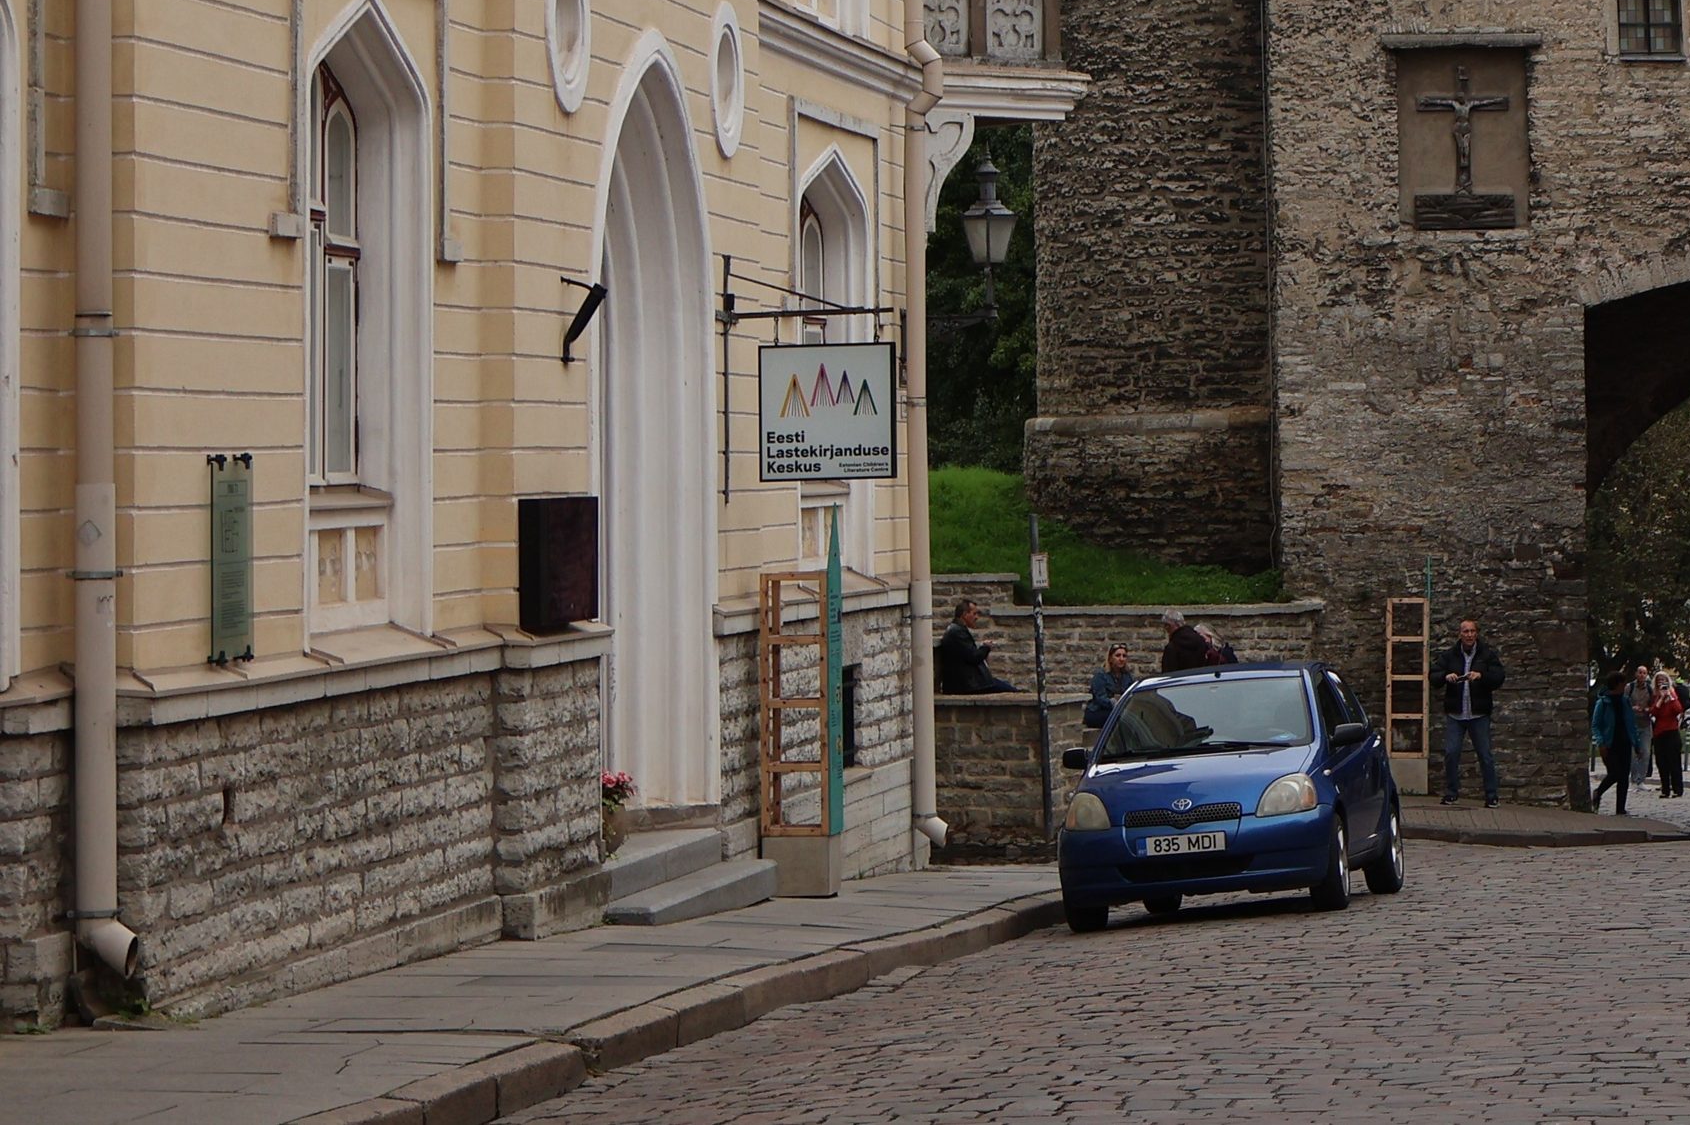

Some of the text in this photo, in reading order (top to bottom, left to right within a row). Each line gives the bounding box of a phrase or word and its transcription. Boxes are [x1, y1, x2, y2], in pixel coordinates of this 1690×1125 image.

[766, 430, 805, 444] Eesti
[766, 444, 890, 460] Lastekirjanduse
[767, 460, 822, 474] Keskus
[1153, 834, 1217, 853] 835 MDI
